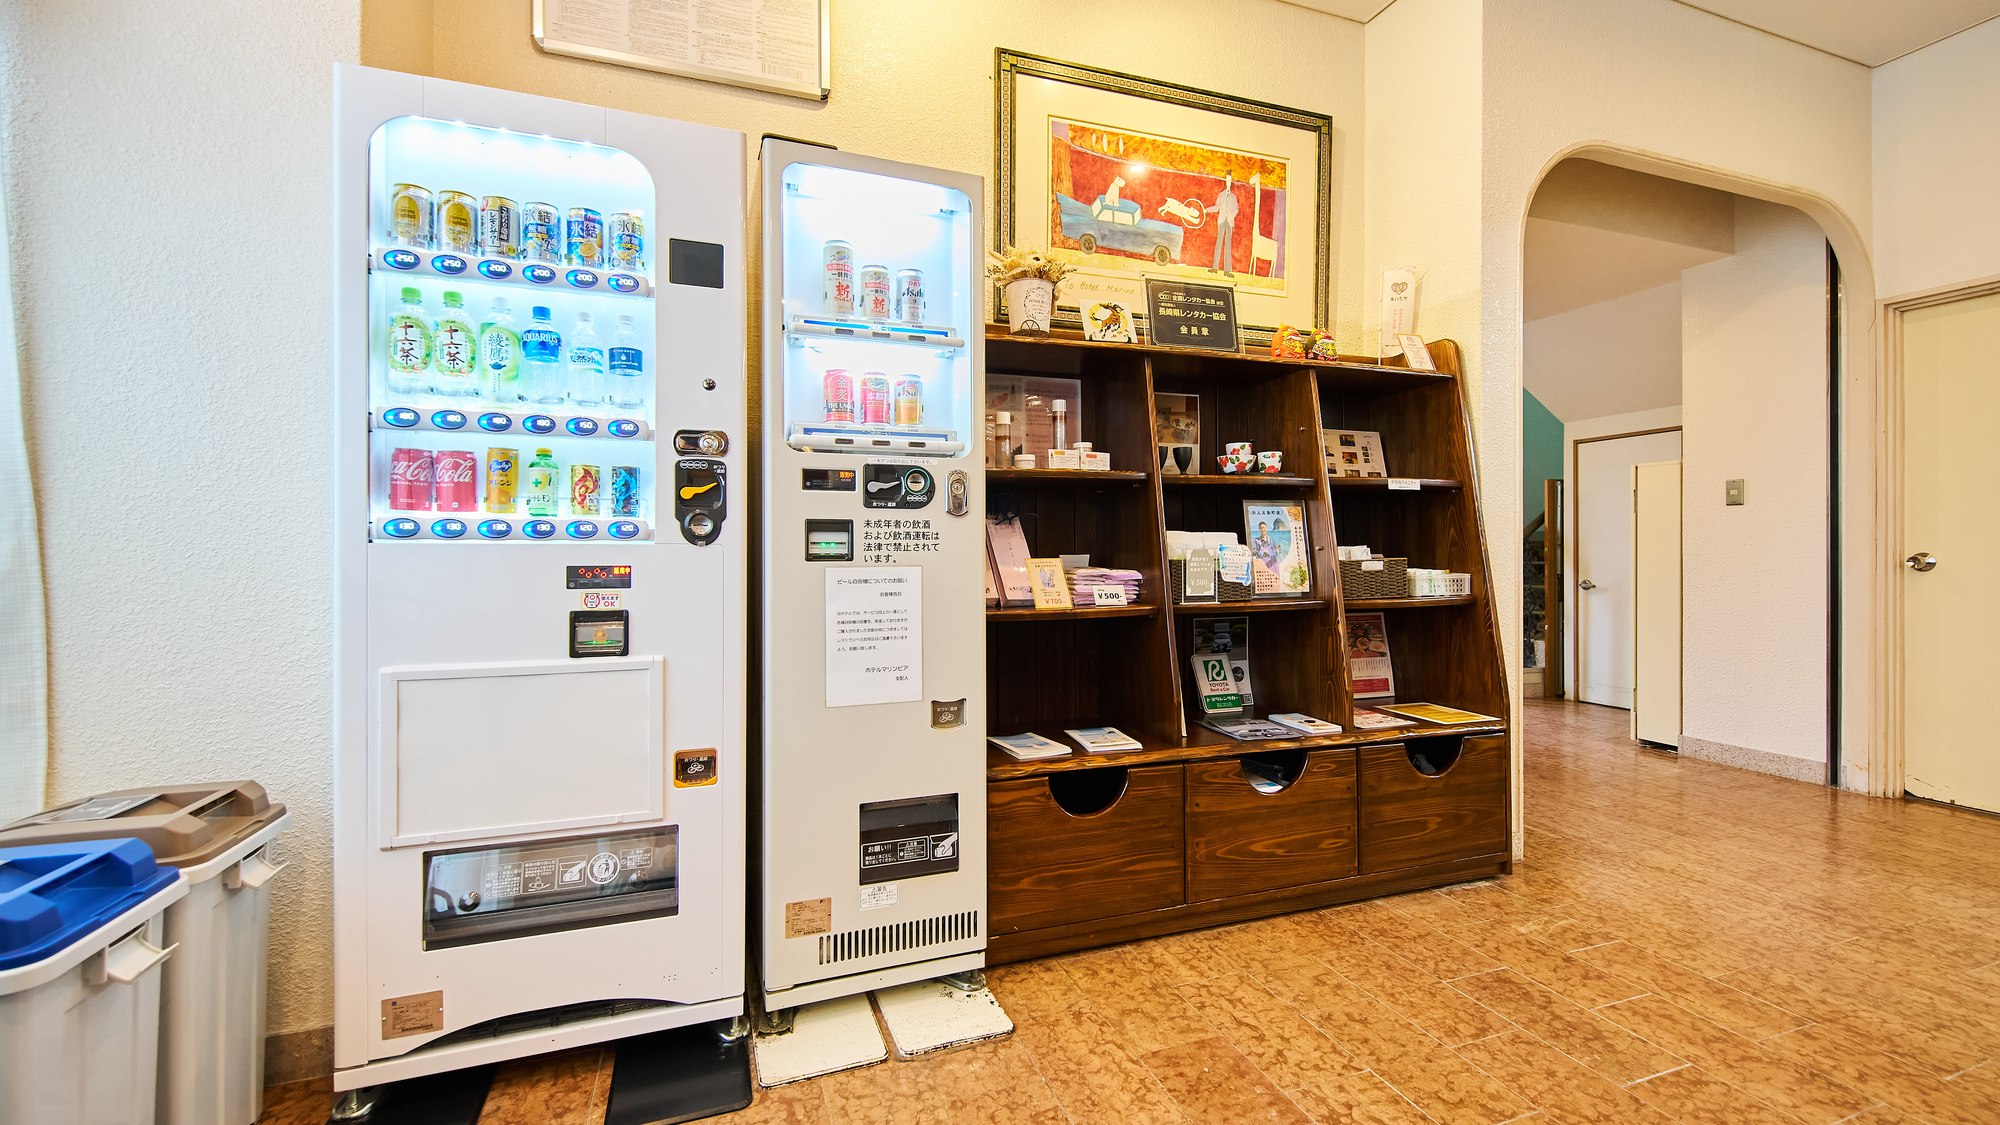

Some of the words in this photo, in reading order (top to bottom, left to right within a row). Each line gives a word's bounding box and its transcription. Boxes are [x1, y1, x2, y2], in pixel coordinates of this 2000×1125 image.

[525, 208, 551, 224] 氷結
[490, 212, 499, 245] レモンサワー
[570, 222, 597, 238] 氷結
[618, 220, 642, 236] 氷結
[444, 260, 461, 268] 250
[490, 264, 506, 272] 200
[534, 269, 550, 277] 200
[836, 282, 850, 298] 新
[1080, 281, 1100, 291] Hotel
[872, 296, 886, 310] 新
[1172, 295, 1215, 305] 全国レンタカー協会
[1159, 307, 1226, 321] 長崎県レンタカー協会
[1180, 325, 1209, 336] 会員章
[397, 321, 419, 365] 十六茶
[442, 325, 466, 370] 十六茶
[488, 333, 504, 362] 綾鷹
[837, 378, 848, 400] 金麦
[490, 479, 512, 487] オレンジ
[864, 520, 930, 529] 未成年者の飲酒
[864, 531, 940, 540] および飲酒運転は
[864, 542, 940, 552] 法律で禁止されて
[864, 554, 897, 564] います。
[614, 567, 630, 575] 販売中
[865, 665, 908, 673] ホテルマリンピア
